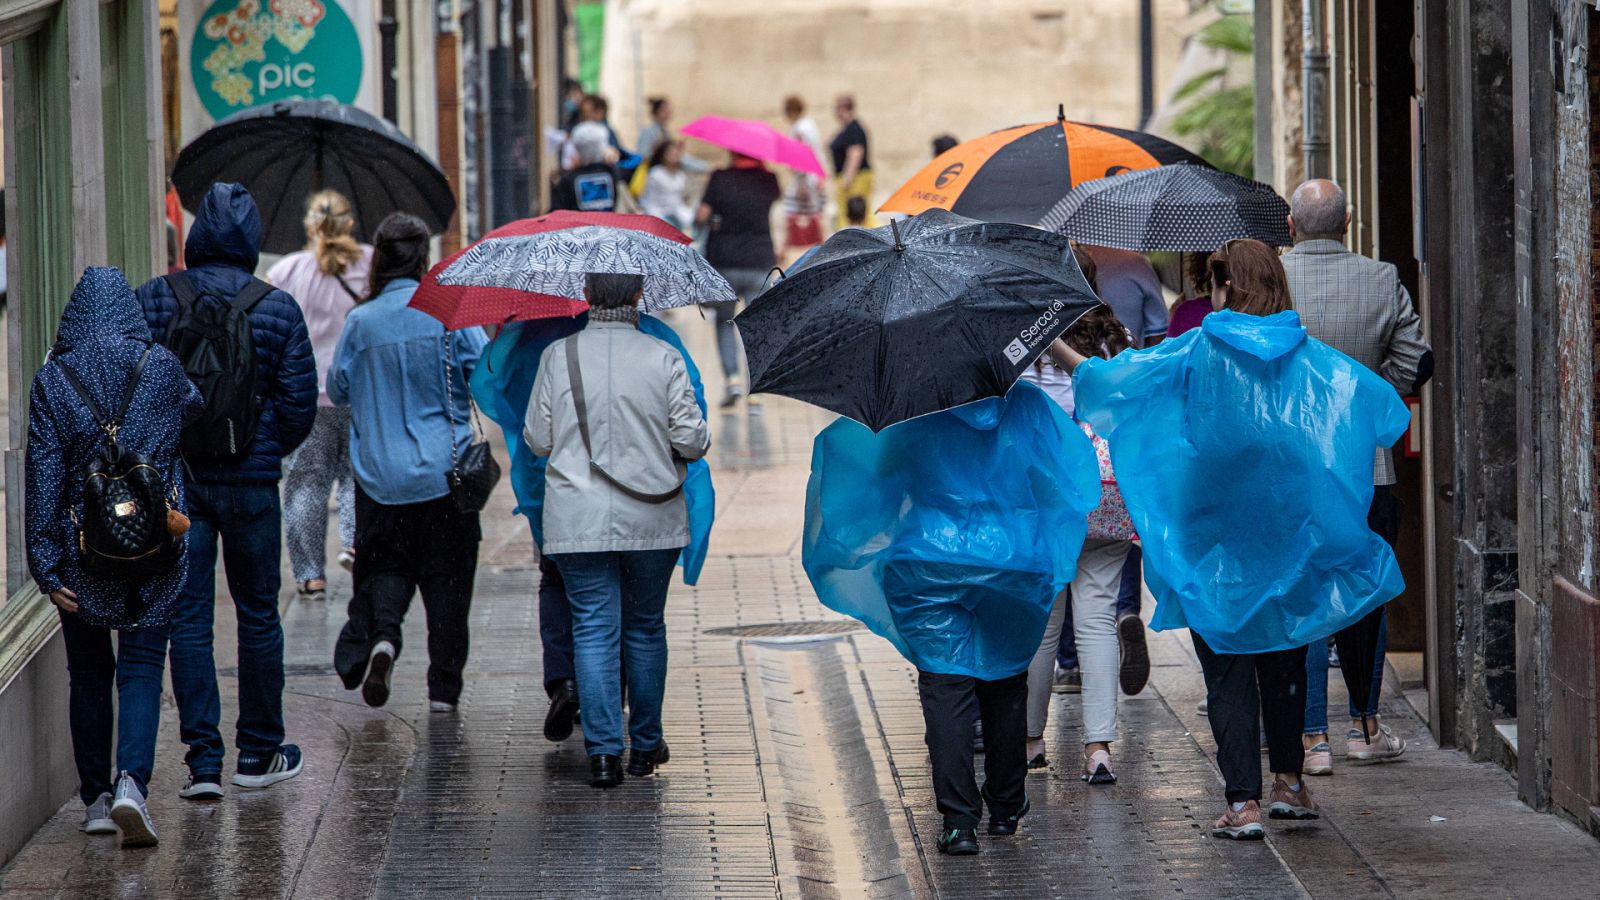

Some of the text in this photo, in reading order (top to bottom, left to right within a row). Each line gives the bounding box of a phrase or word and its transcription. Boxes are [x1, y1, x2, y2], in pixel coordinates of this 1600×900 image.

[258, 55, 316, 97] pic
[1020, 299, 1065, 342] Sercotel
[1028, 318, 1060, 349] Hotel Group
[1008, 344, 1022, 358] S
